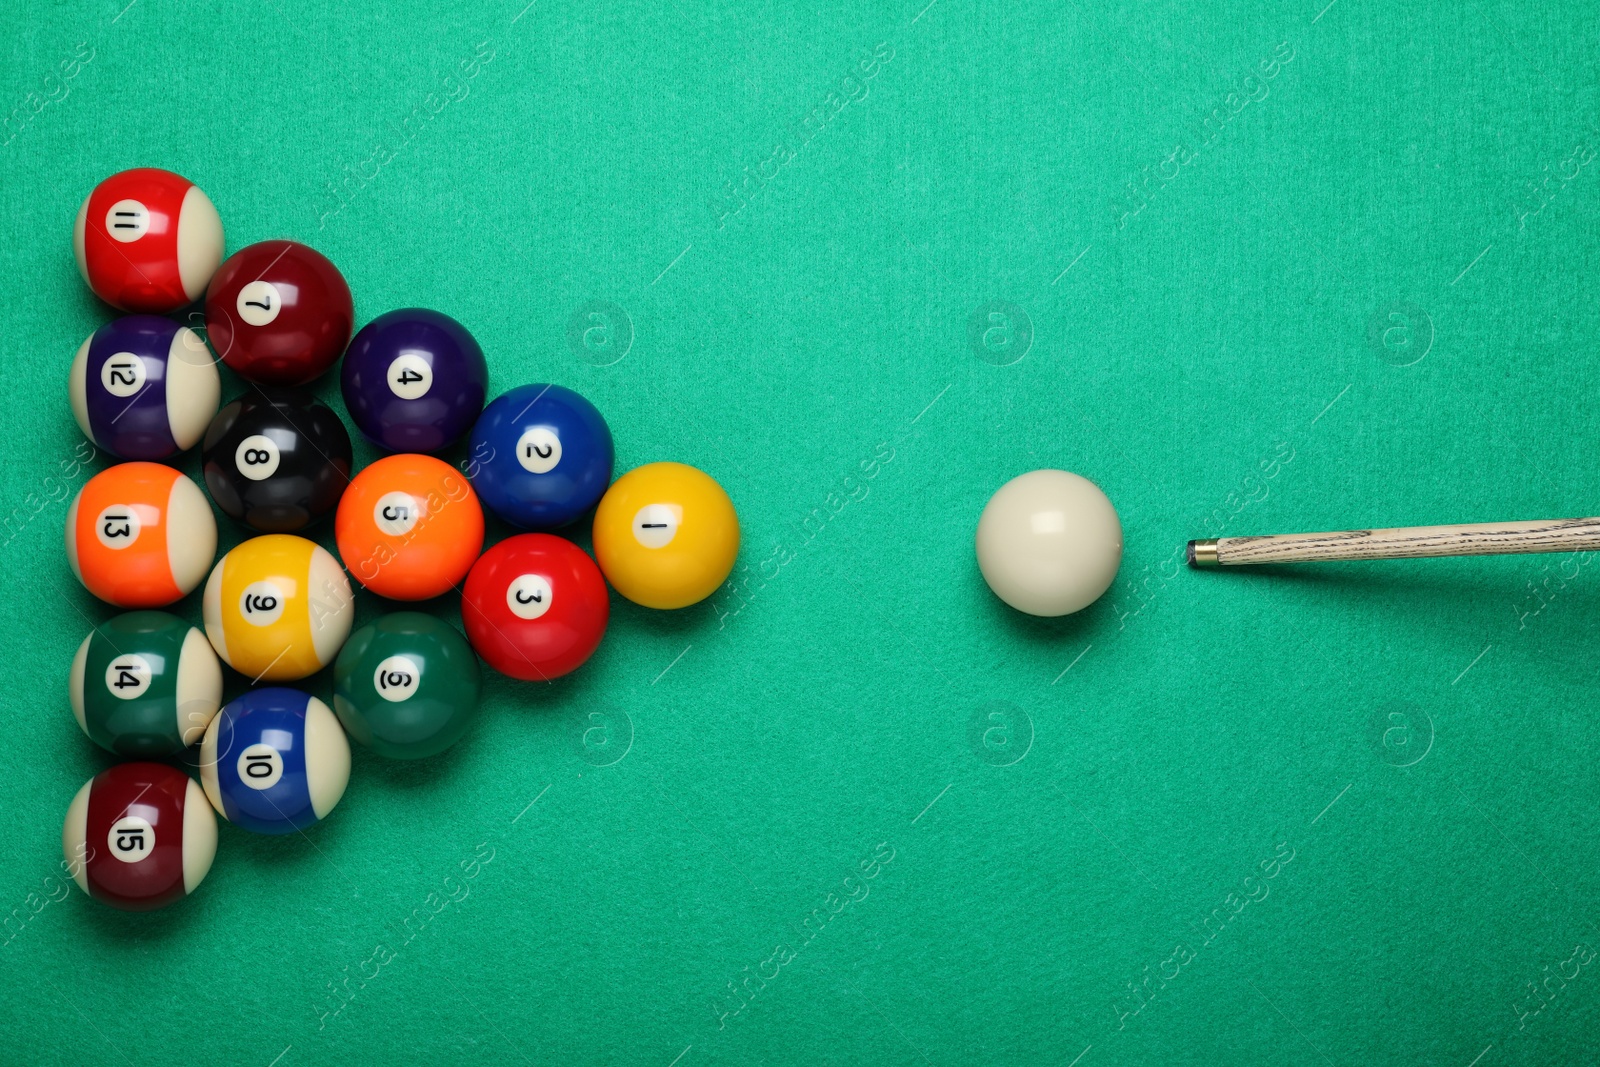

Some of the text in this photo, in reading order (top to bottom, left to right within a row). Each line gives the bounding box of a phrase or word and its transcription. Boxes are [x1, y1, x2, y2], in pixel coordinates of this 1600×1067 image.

[114, 211, 141, 229] 11
[245, 295, 271, 311] 7
[110, 363, 137, 386] 12
[397, 366, 423, 385] 4
[244, 448, 270, 466] 8
[525, 442, 553, 459] 2
[382, 505, 408, 521] 5
[103, 515, 131, 538] 13
[252, 595, 277, 612] 9
[515, 588, 543, 605] 3
[113, 665, 141, 689] 14
[388, 671, 412, 687] 6
[246, 754, 273, 778] 10
[116, 828, 144, 852] 15
